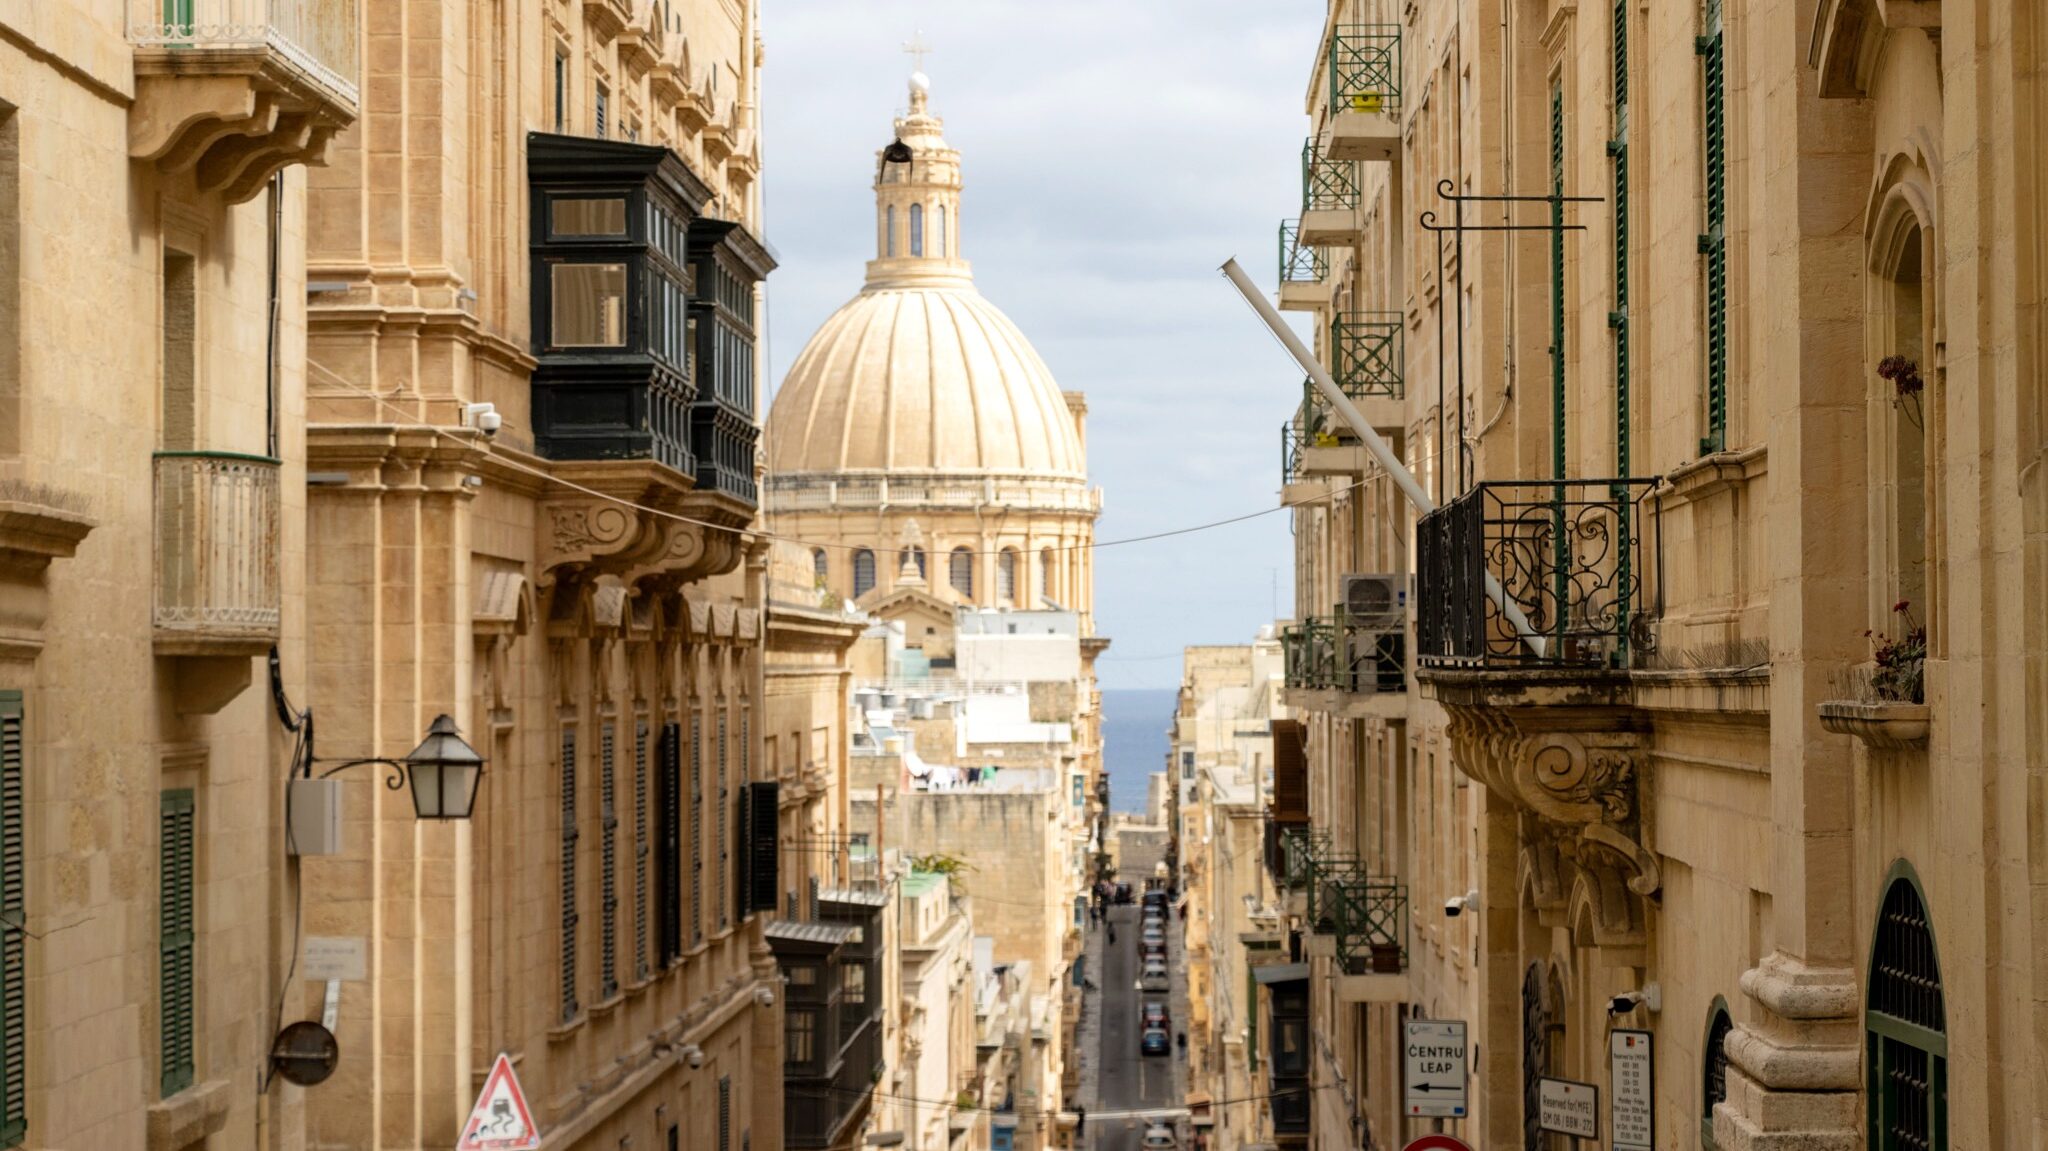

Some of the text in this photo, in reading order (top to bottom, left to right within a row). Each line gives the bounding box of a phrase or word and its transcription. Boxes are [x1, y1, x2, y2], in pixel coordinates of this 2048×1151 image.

[1409, 1043, 1463, 1058] ĊENTRU
[1421, 1062, 1453, 1074] LEAP
[1543, 1095, 1566, 1110] Reserved
